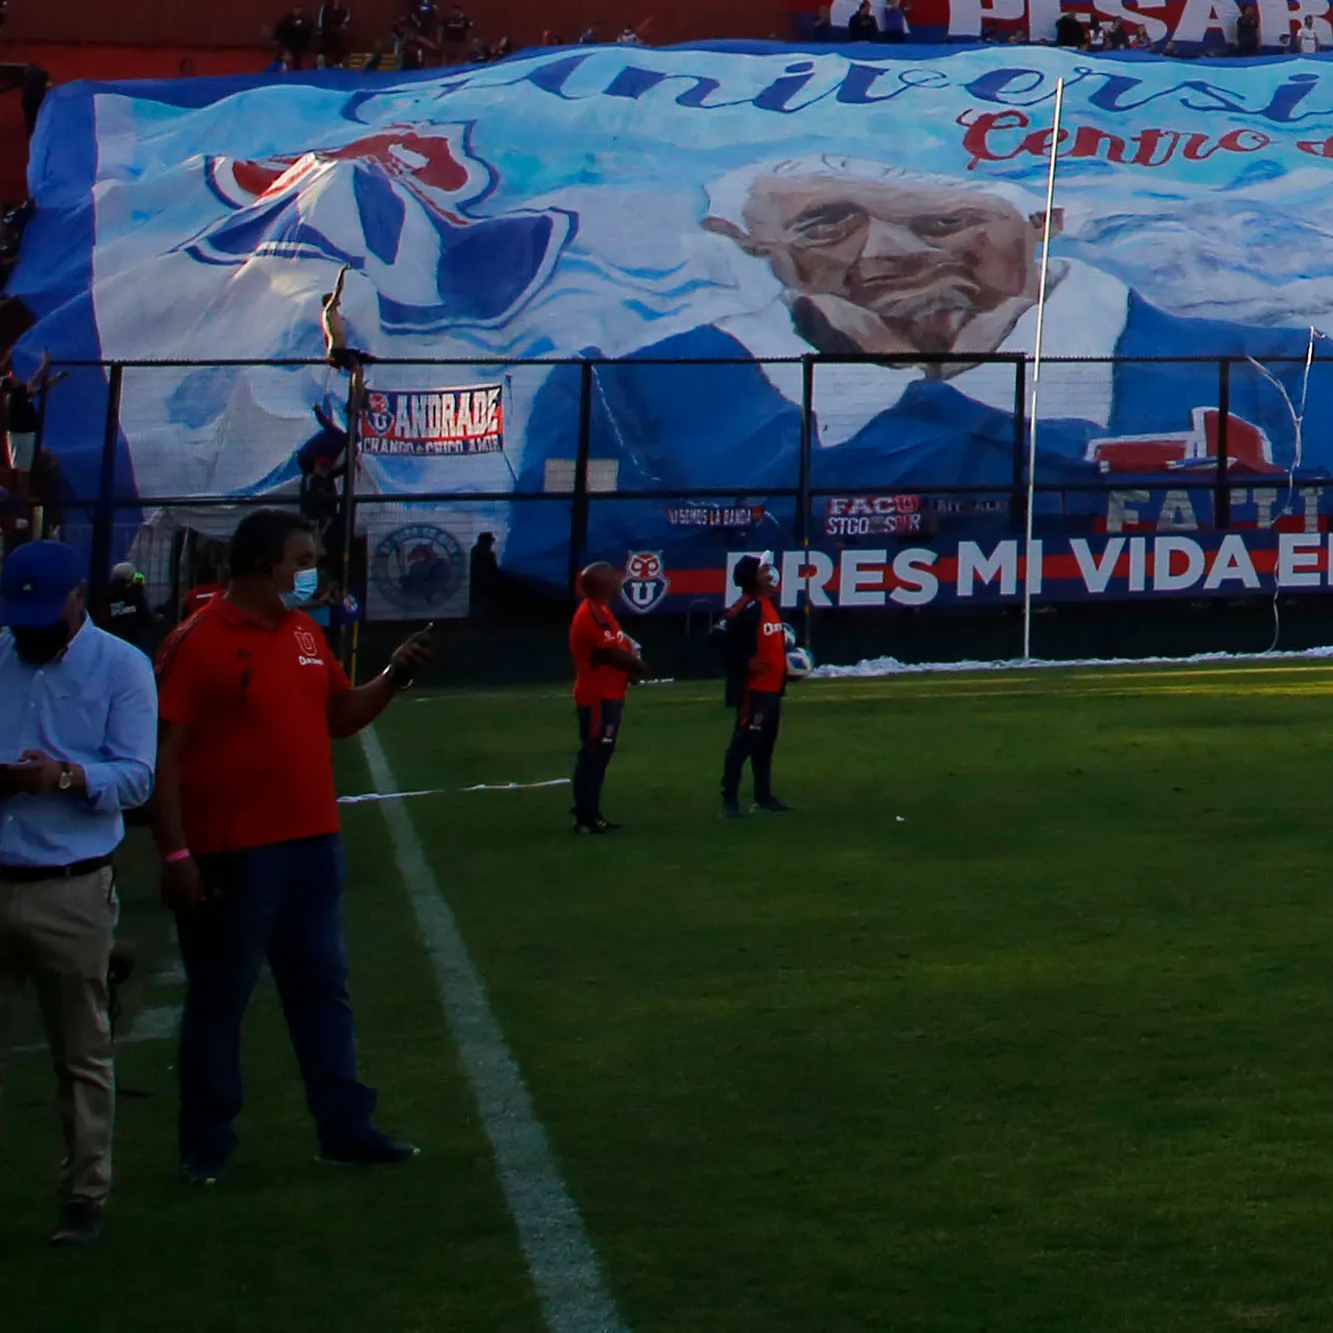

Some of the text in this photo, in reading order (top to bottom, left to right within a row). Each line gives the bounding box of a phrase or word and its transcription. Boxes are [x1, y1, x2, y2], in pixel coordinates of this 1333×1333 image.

[956, 108, 1270, 169] Centro
[395, 388, 500, 439] ANDRADE
[957, 538, 1044, 597] MI
[1070, 533, 1262, 596] VIDA
